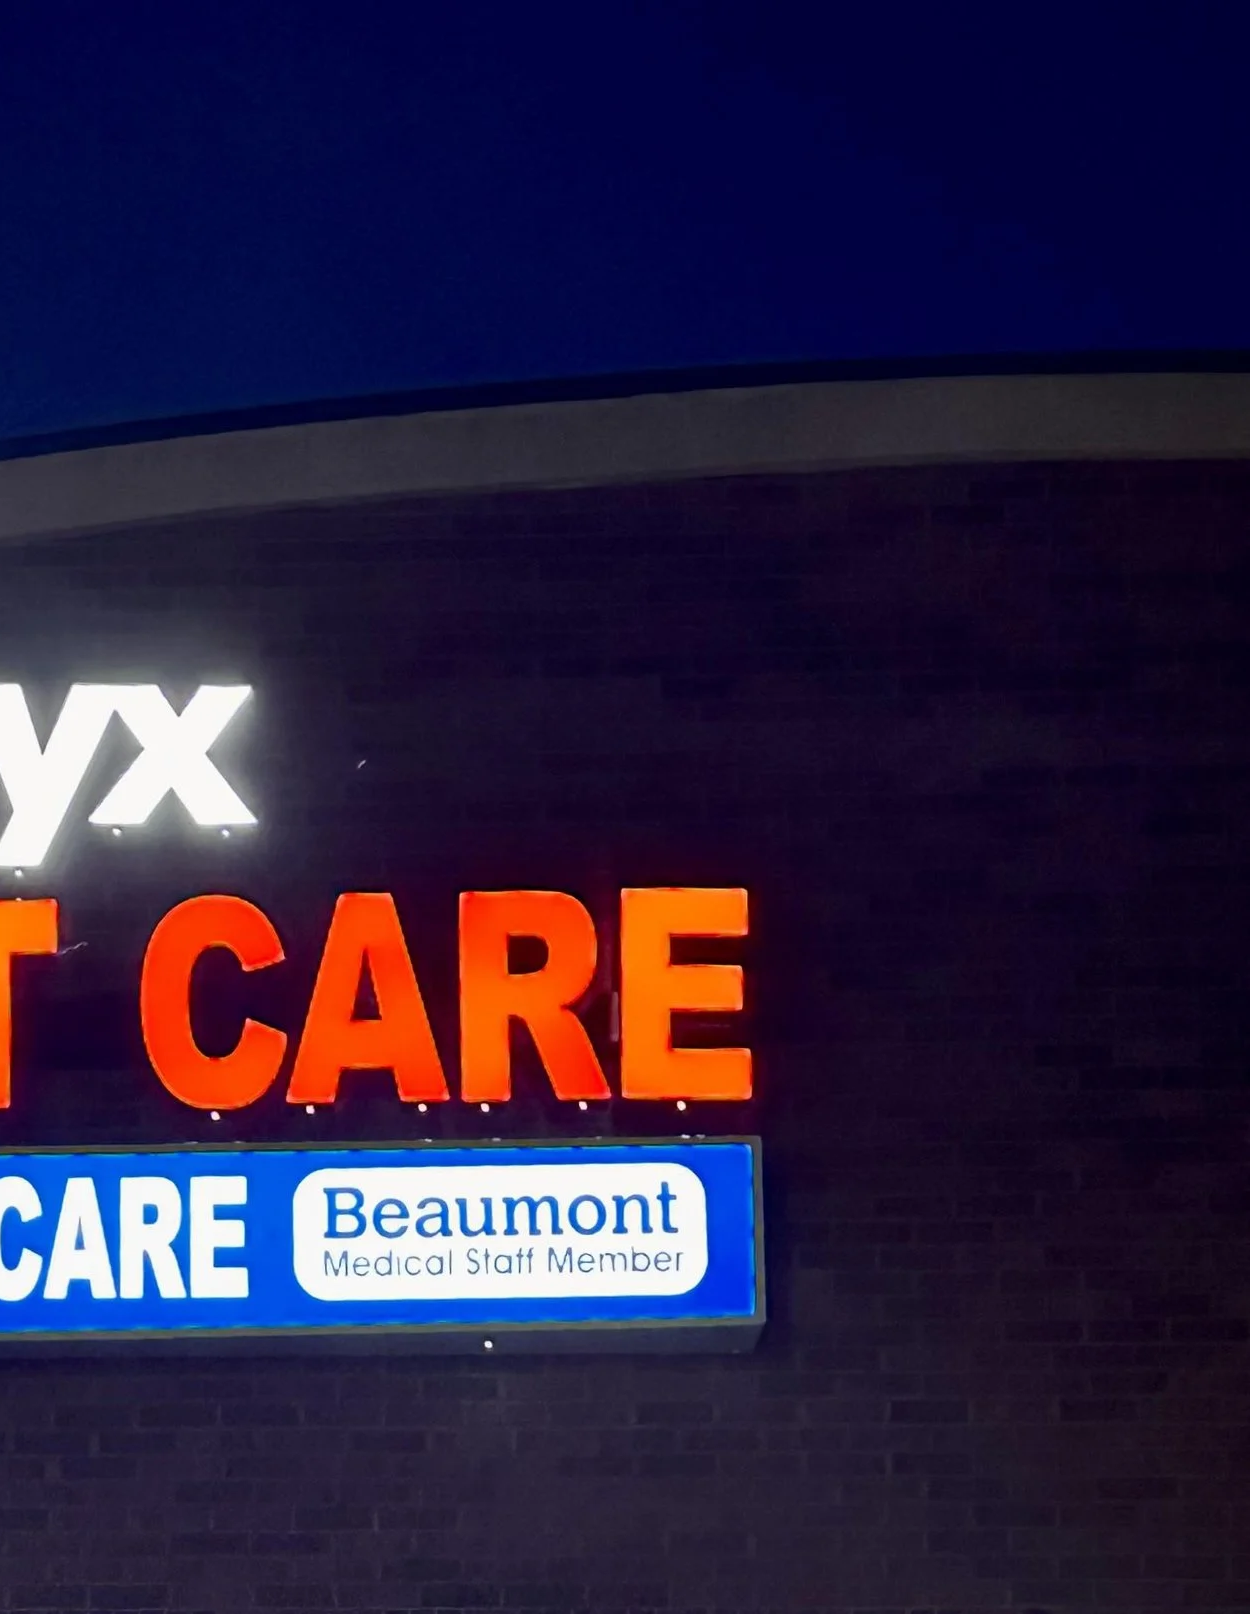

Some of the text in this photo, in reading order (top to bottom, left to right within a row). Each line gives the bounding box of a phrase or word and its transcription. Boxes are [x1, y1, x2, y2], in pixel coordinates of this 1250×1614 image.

[140, 886, 753, 1110] CARE
[322, 1181, 679, 1239] Beaumont
[323, 1246, 684, 1277] Medical Staff Member
